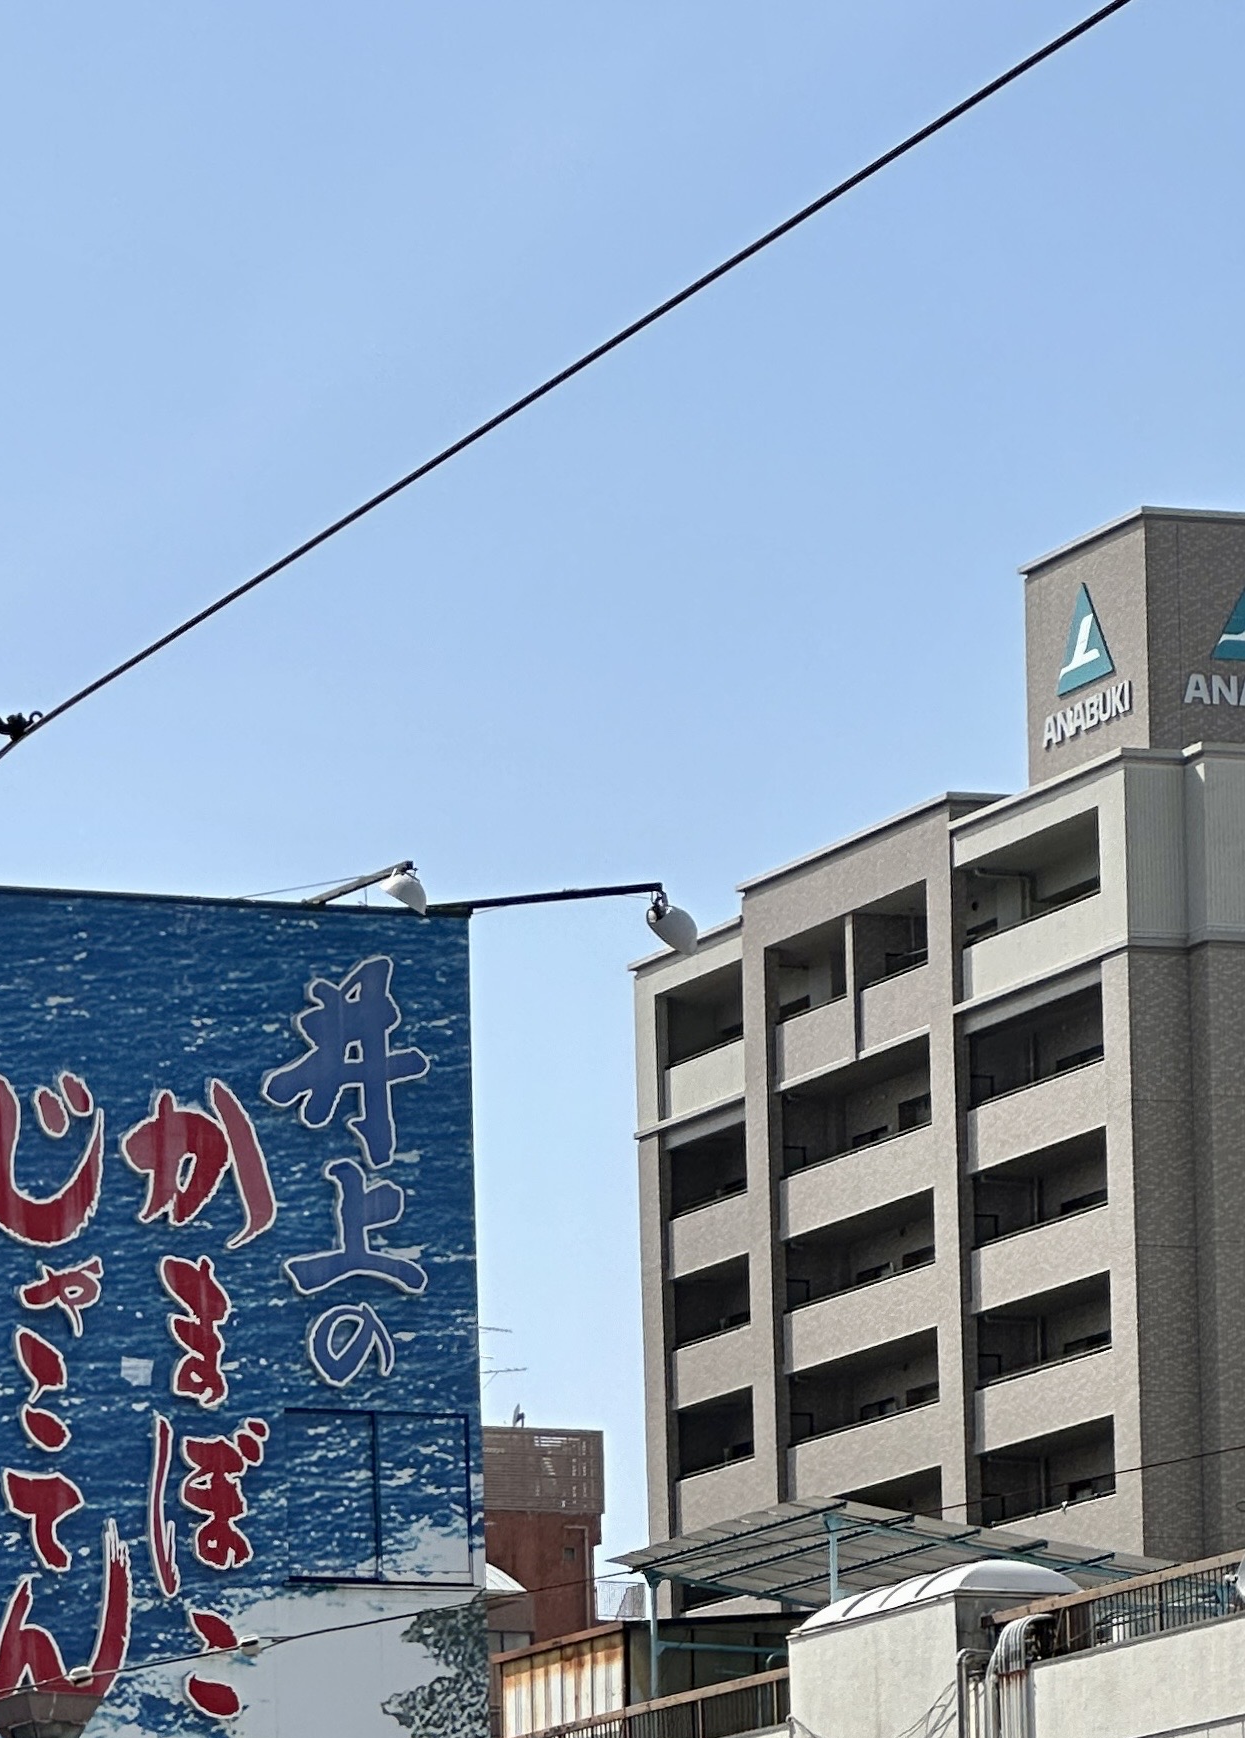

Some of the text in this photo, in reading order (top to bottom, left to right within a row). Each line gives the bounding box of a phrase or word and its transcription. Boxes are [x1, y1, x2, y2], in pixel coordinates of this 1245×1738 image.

[1042, 680, 1132, 749] ANABUKI
[1183, 673, 1245, 707] AN
[262, 955, 431, 1388] 井上の
[120, 1079, 277, 1721] かまぼこ
